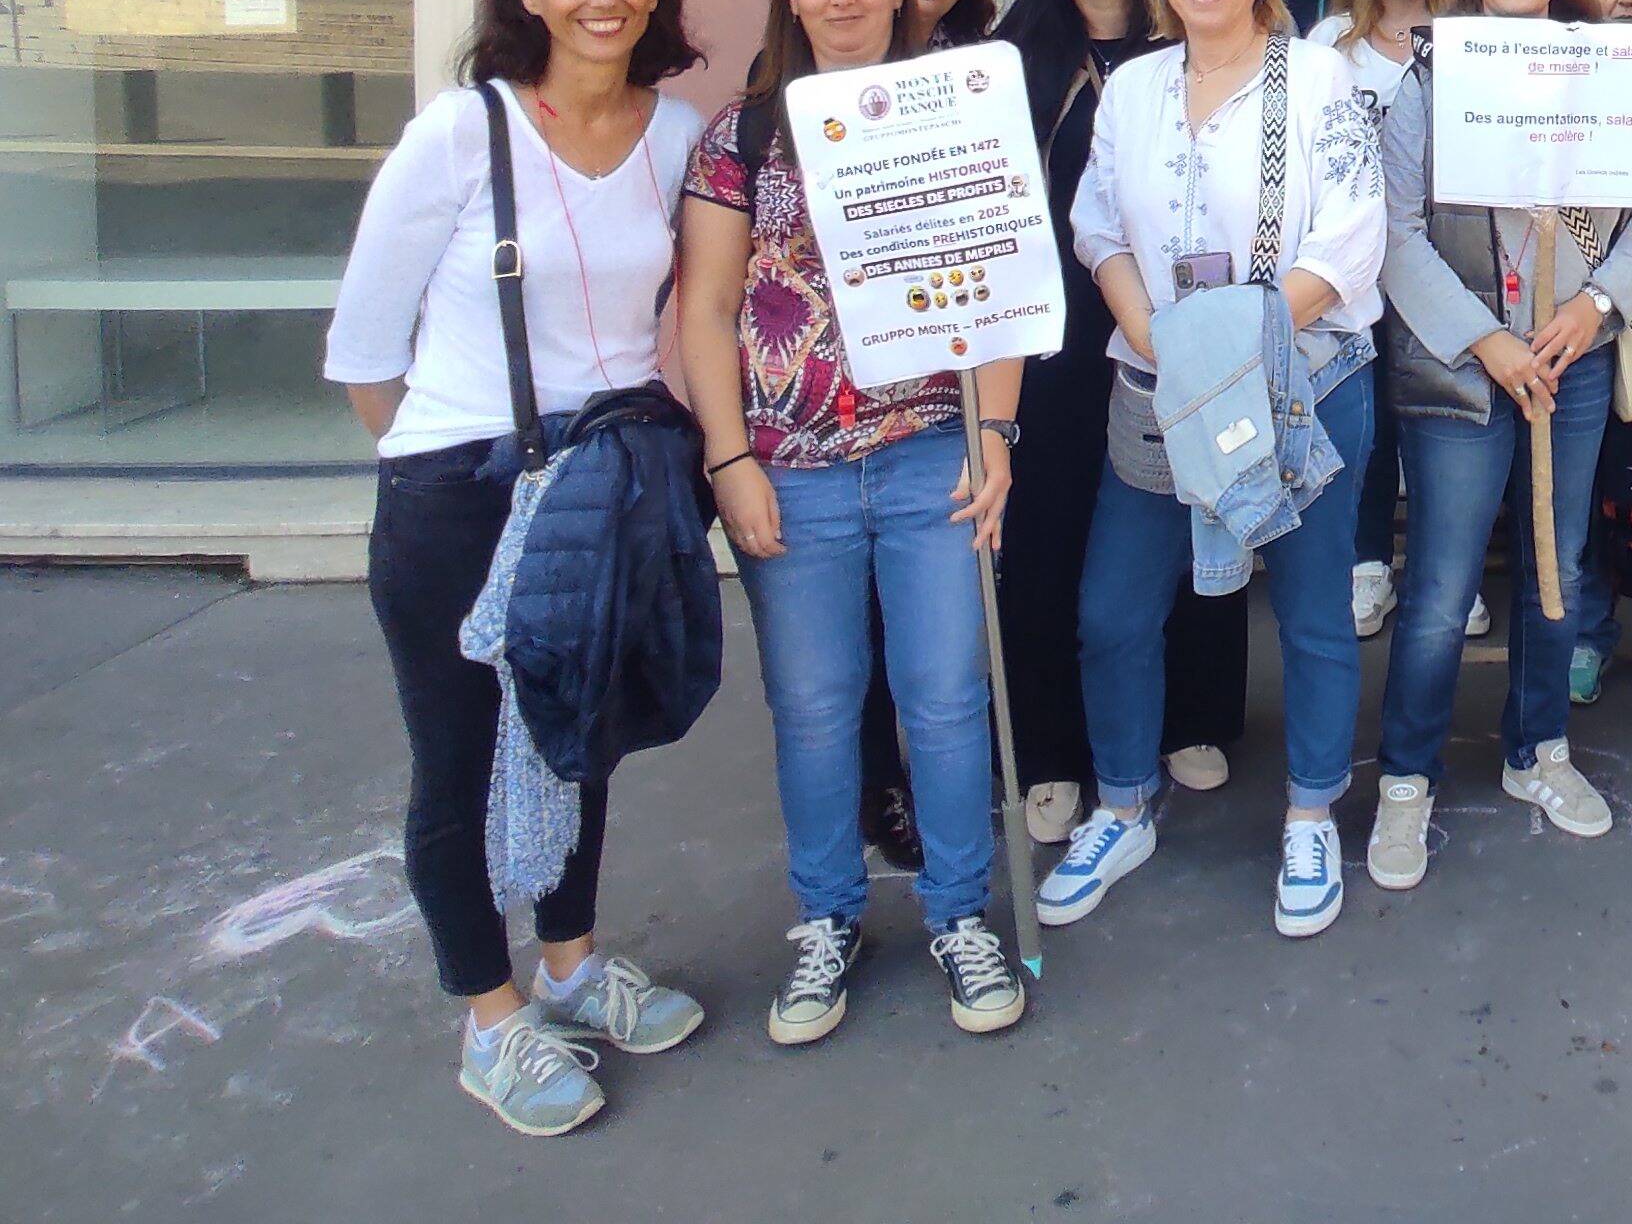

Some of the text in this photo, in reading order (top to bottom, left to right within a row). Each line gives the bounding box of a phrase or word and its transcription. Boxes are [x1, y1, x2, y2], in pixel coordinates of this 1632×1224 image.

[1463, 40, 1497, 56] Stop
[1501, 41, 1510, 54] à
[1514, 42, 1592, 58] l'esclavage
[1595, 43, 1608, 56] et
[1527, 61, 1544, 73] de
[895, 70, 953, 89] MONTE
[896, 82, 955, 103] PASCHI
[898, 96, 957, 117] BANQUE
[1464, 110, 1492, 124] Des
[1529, 131, 1546, 143] en
[836, 138, 1001, 178] BANQUE FONDÉE EN 1472
[834, 157, 1009, 200] Un patrimoine HISTORIQUE
[848, 179, 1005, 219] DES SIECLES DE PROFITS
[958, 213, 976, 224] en
[978, 203, 1011, 220] 2025
[839, 249, 864, 261] Des
[866, 236, 931, 257] conditions
[865, 239, 1016, 278] DES ANNEES DE MEPRIS
[862, 326, 915, 347] GRUPPO
[917, 323, 960, 337] MONTE
[974, 303, 1052, 329] PAS-CHICHE
